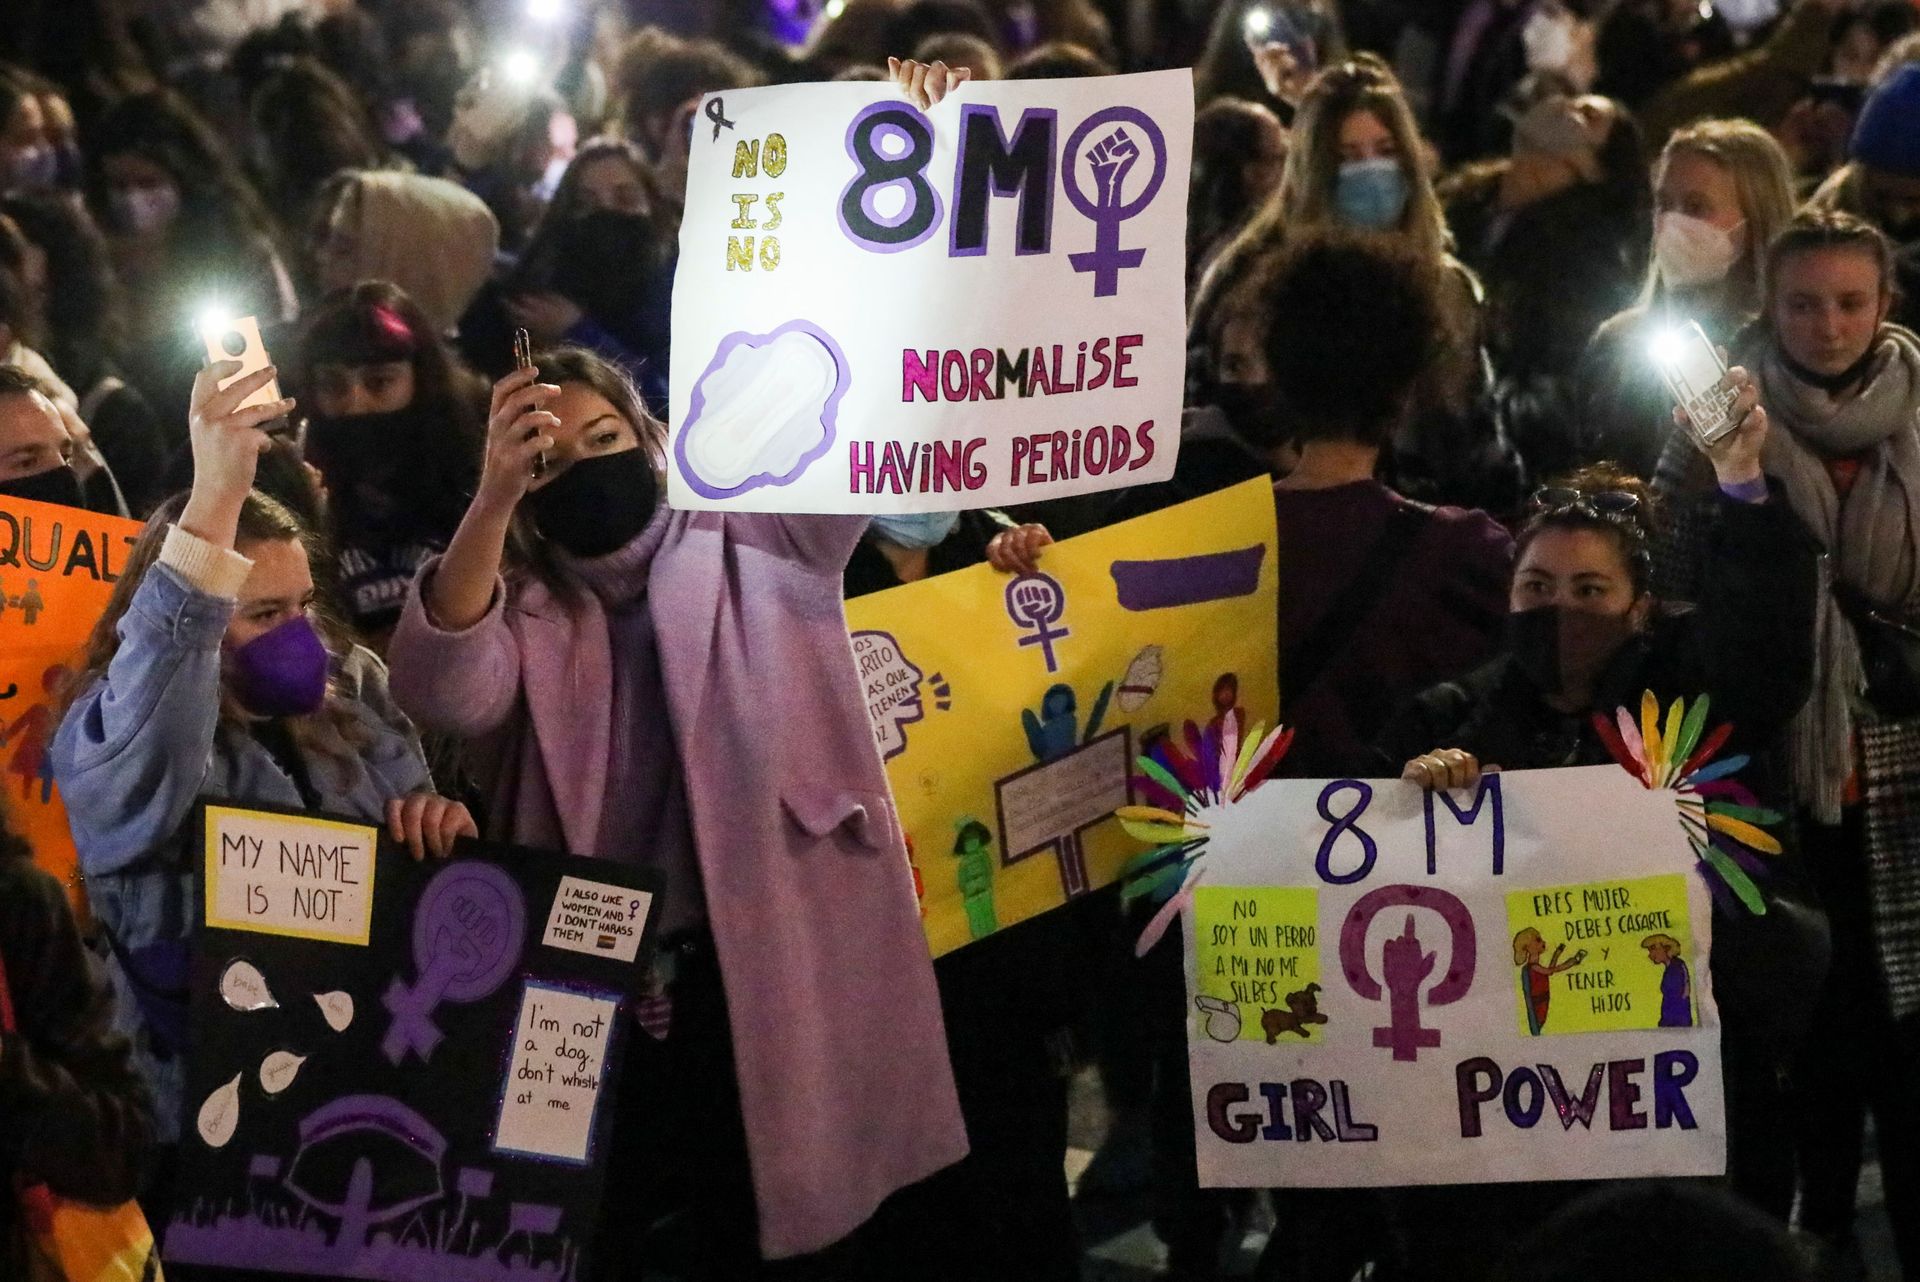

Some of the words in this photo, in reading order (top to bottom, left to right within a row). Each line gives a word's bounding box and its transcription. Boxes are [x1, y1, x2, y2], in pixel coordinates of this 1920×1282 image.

[732, 133, 787, 178] NO
[732, 191, 784, 229] IS
[726, 236, 781, 272] NO
[886, 669, 910, 687] QUE
[223, 832, 263, 869] MY
[280, 840, 359, 885] NAME
[247, 884, 268, 915] IS
[565, 887, 570, 897] I
[572, 889, 598, 901] ALSO
[601, 894, 624, 906] LIKE
[1533, 891, 1573, 917] ERES
[561, 901, 601, 917] WOMEN
[602, 910, 624, 922] AND
[1233, 899, 1257, 921] NO
[553, 927, 584, 943] THEM
[557, 913, 562, 924] I
[598, 922, 634, 937] HARASS
[1211, 924, 1238, 946] SOY
[1249, 926, 1268, 948] UN
[1276, 925, 1316, 948] PERRO
[1564, 916, 1612, 942] DEBES
[1618, 909, 1673, 934] CASARTE
[1216, 955, 1226, 976] A
[1256, 957, 1274, 976] NO
[1280, 956, 1299, 978] ME
[1566, 969, 1616, 991] TENER
[530, 1003, 560, 1032] I'm
[573, 1014, 605, 1038] not
[524, 1039, 538, 1051] a
[517, 1057, 555, 1084] don't
[561, 1073, 599, 1091] whistle
[517, 1090, 533, 1105] at
[547, 1098, 571, 1111] me
[1205, 1078, 1379, 1144] GIRL
[1455, 1049, 1700, 1138] POWER
